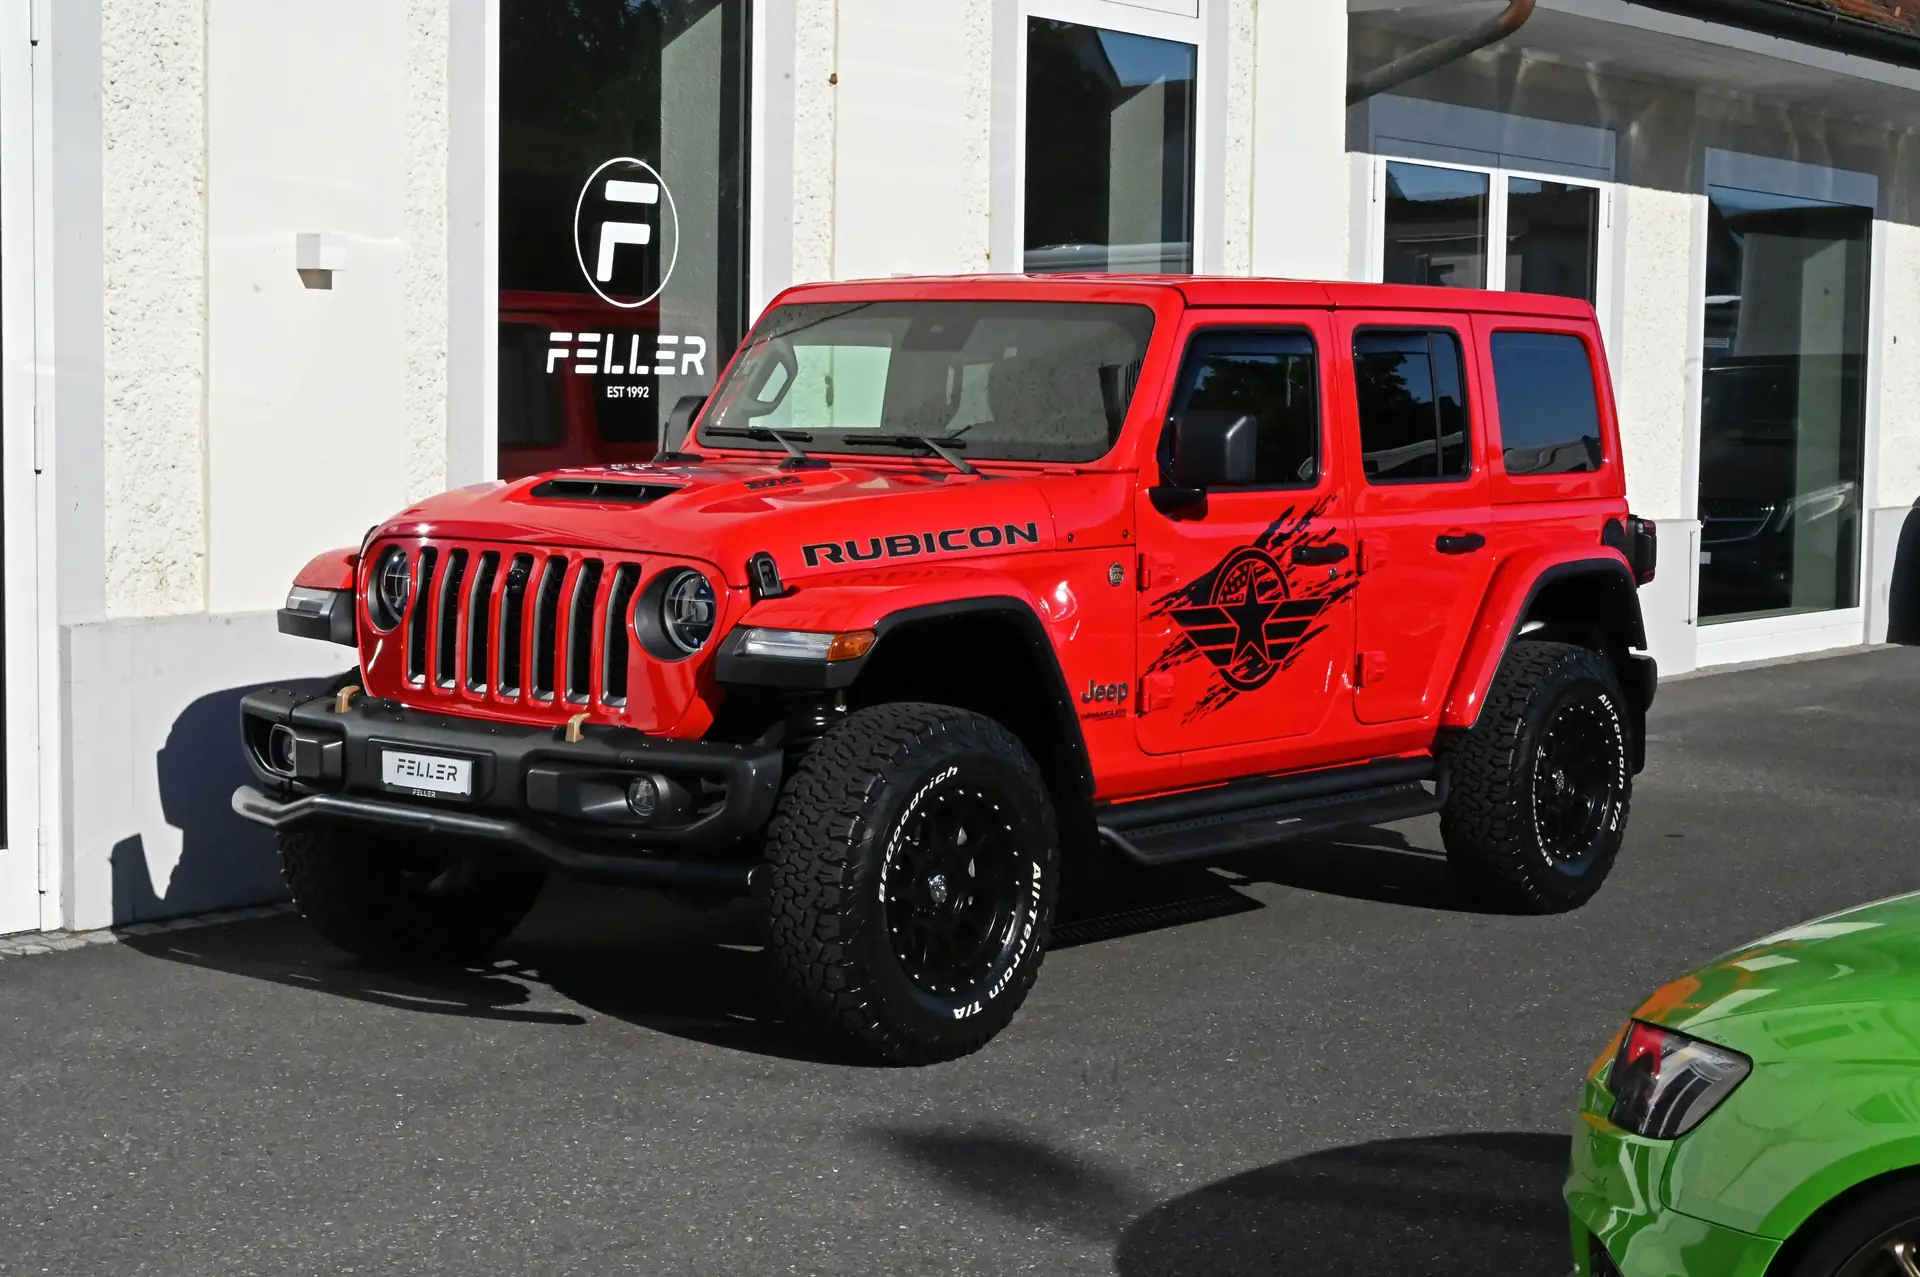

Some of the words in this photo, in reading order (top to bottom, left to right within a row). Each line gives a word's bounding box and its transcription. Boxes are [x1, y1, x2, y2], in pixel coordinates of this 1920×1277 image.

[597, 180, 659, 282] F
[546, 332, 707, 376] FELLER
[607, 386, 625, 398] EST
[627, 386, 650, 398] 1992
[801, 522, 1040, 568] RUBICON
[1080, 680, 1129, 706] Jeep
[396, 758, 458, 782] FELLER
[412, 788, 436, 798] FELLER
[878, 765, 958, 903] BFGoodrich
[988, 861, 1042, 1000] All-Terrain
[953, 1000, 983, 1020] T/A
